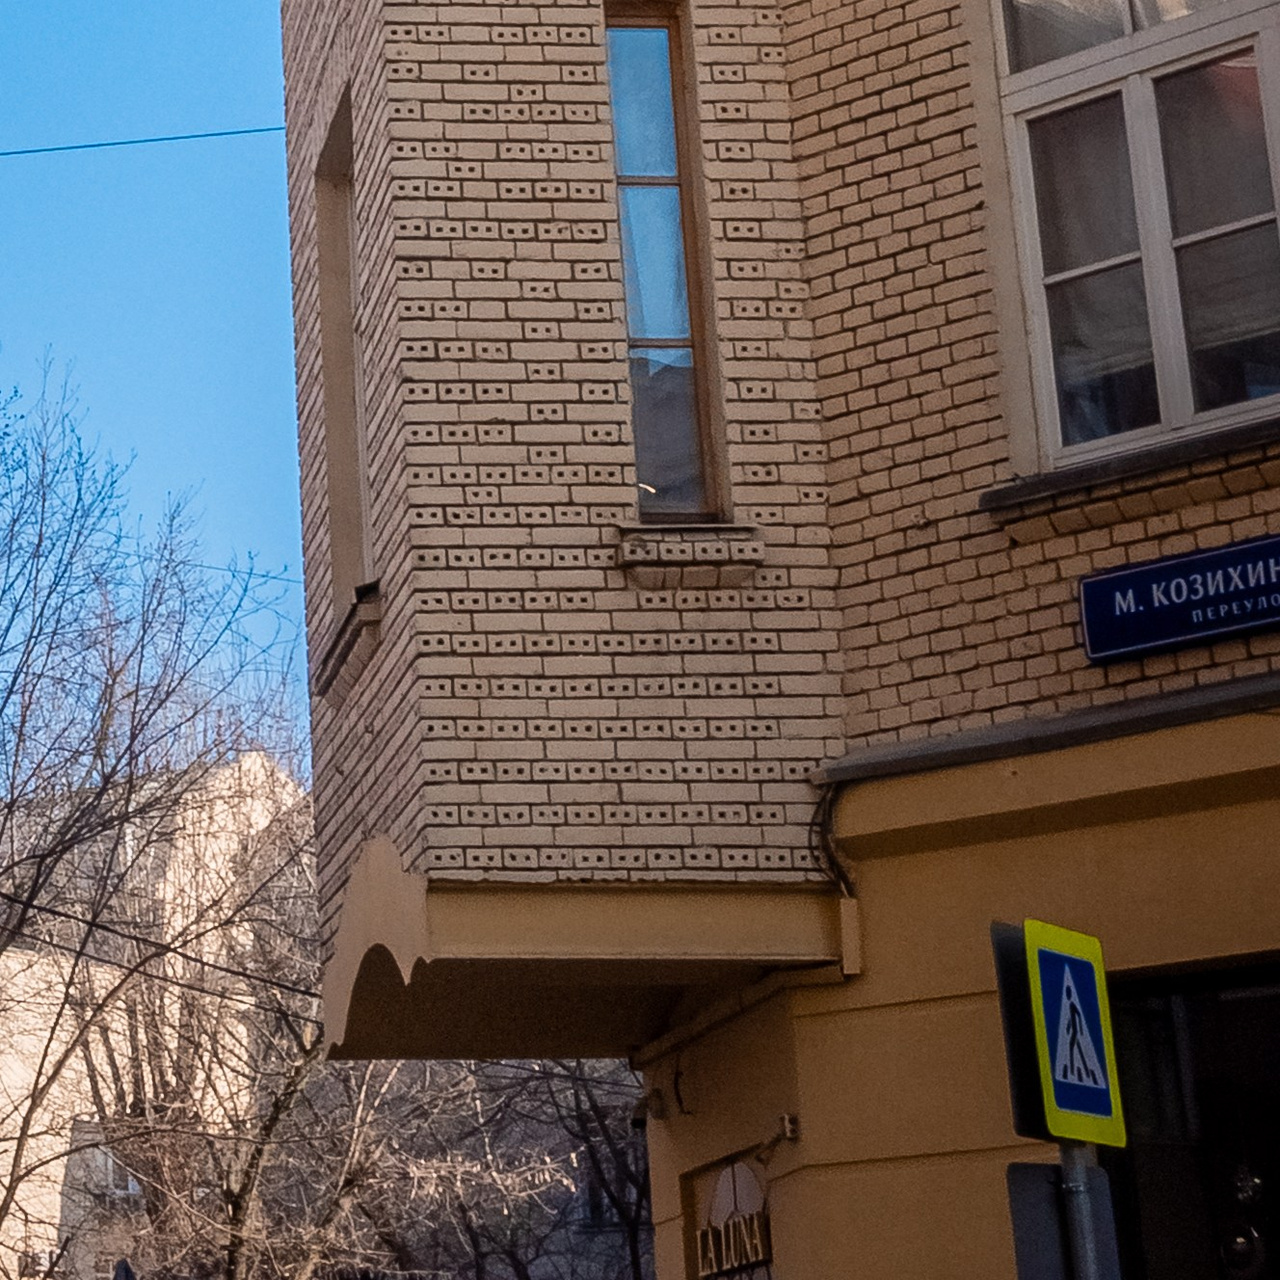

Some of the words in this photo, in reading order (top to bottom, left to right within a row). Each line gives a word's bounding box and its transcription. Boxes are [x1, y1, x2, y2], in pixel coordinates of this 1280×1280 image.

[1115, 589, 1144, 615] М.
[696, 1226, 718, 1276] LA
[721, 1213, 763, 1271] LUNA
